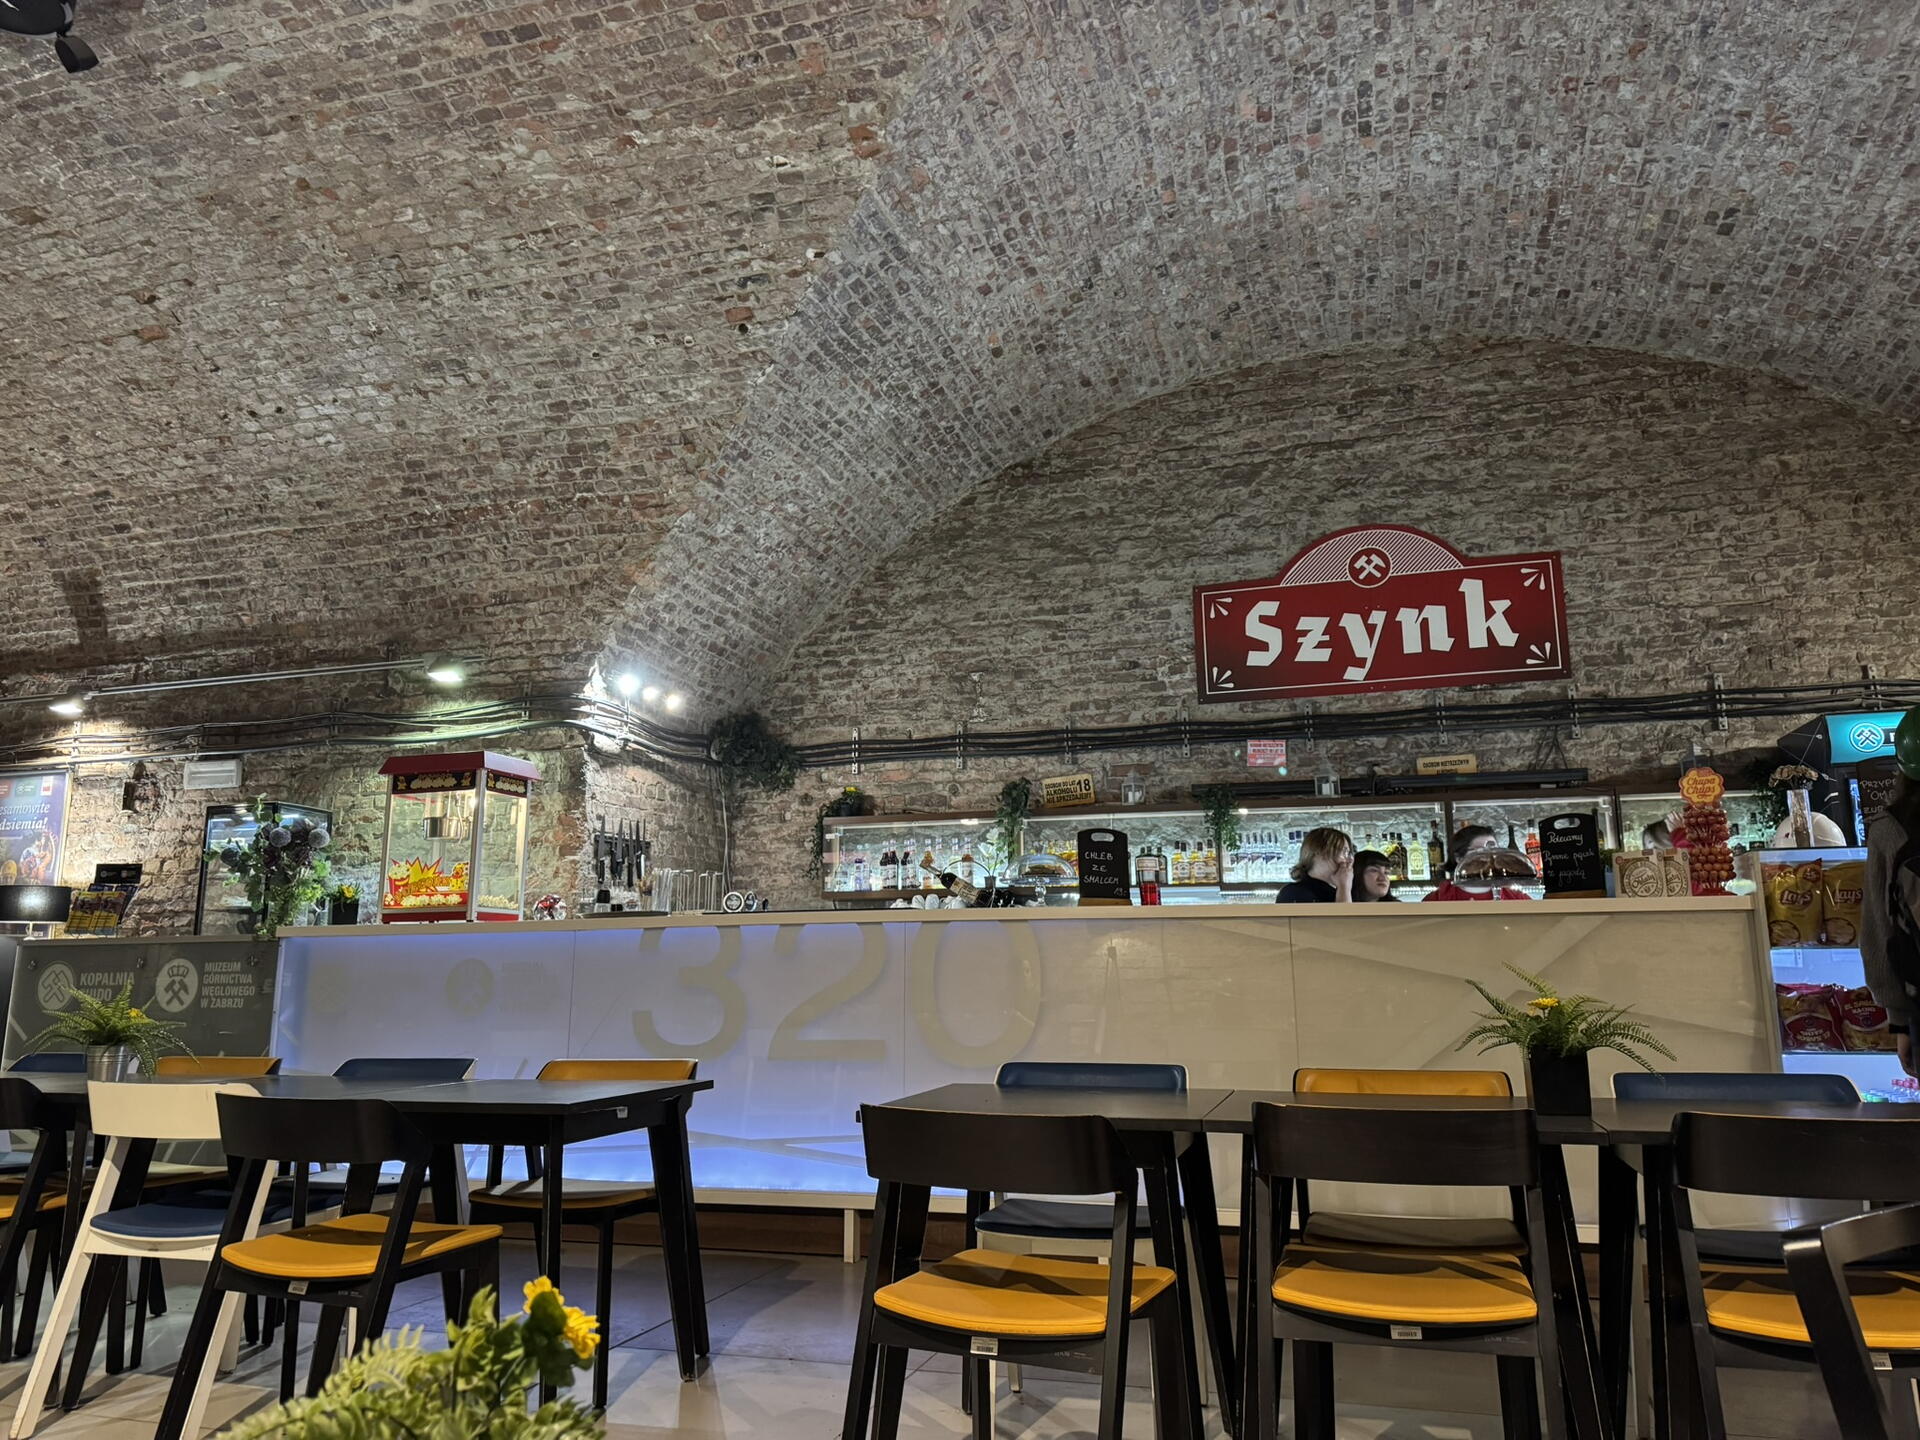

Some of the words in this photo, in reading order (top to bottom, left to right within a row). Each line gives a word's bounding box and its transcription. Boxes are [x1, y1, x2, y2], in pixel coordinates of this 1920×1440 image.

[1245, 578, 1519, 680] Szynk
[1076, 778, 1091, 792] 18
[1687, 777, 1716, 785] Chupa
[1686, 785, 1716, 795] Chups
[1091, 864, 1108, 872] ZE
[1083, 875, 1119, 885] SMALCEM
[204, 961, 241, 972] MUZEUM
[80, 971, 135, 986] KOPALNIA
[203, 972, 253, 984] GÓRNICTWA
[200, 998, 209, 1008] W
[210, 998, 244, 1009] ZABRZU
